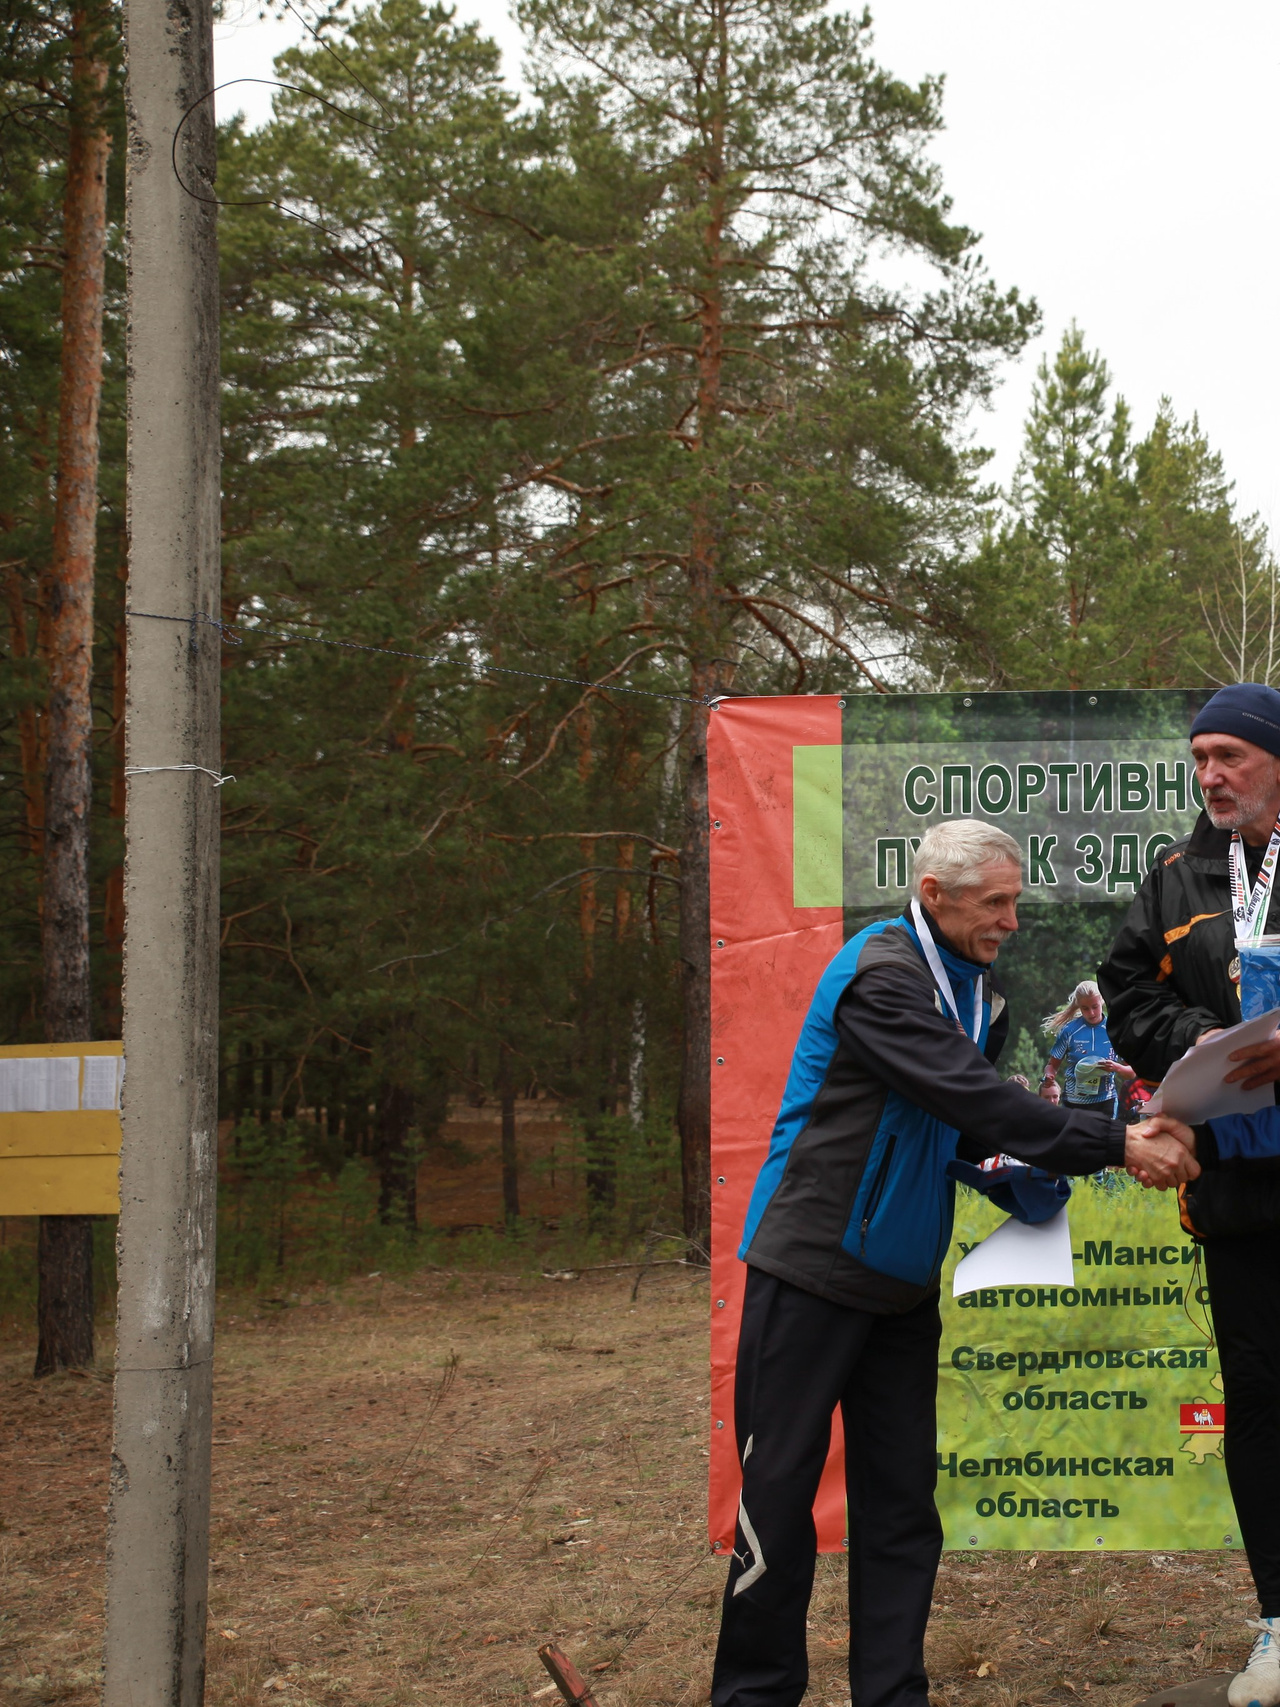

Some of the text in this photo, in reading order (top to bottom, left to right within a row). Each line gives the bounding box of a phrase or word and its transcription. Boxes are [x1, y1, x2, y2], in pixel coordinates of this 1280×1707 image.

[903, 760, 1204, 816] СПОРТИВН
[1028, 833, 1058, 886] К
[957, 1279, 1183, 1309] автономный
[950, 1346, 1208, 1377] Свердловская
[1002, 1385, 1148, 1411] область
[936, 1451, 1174, 1478] Челябинская
[975, 1491, 1120, 1518] область
